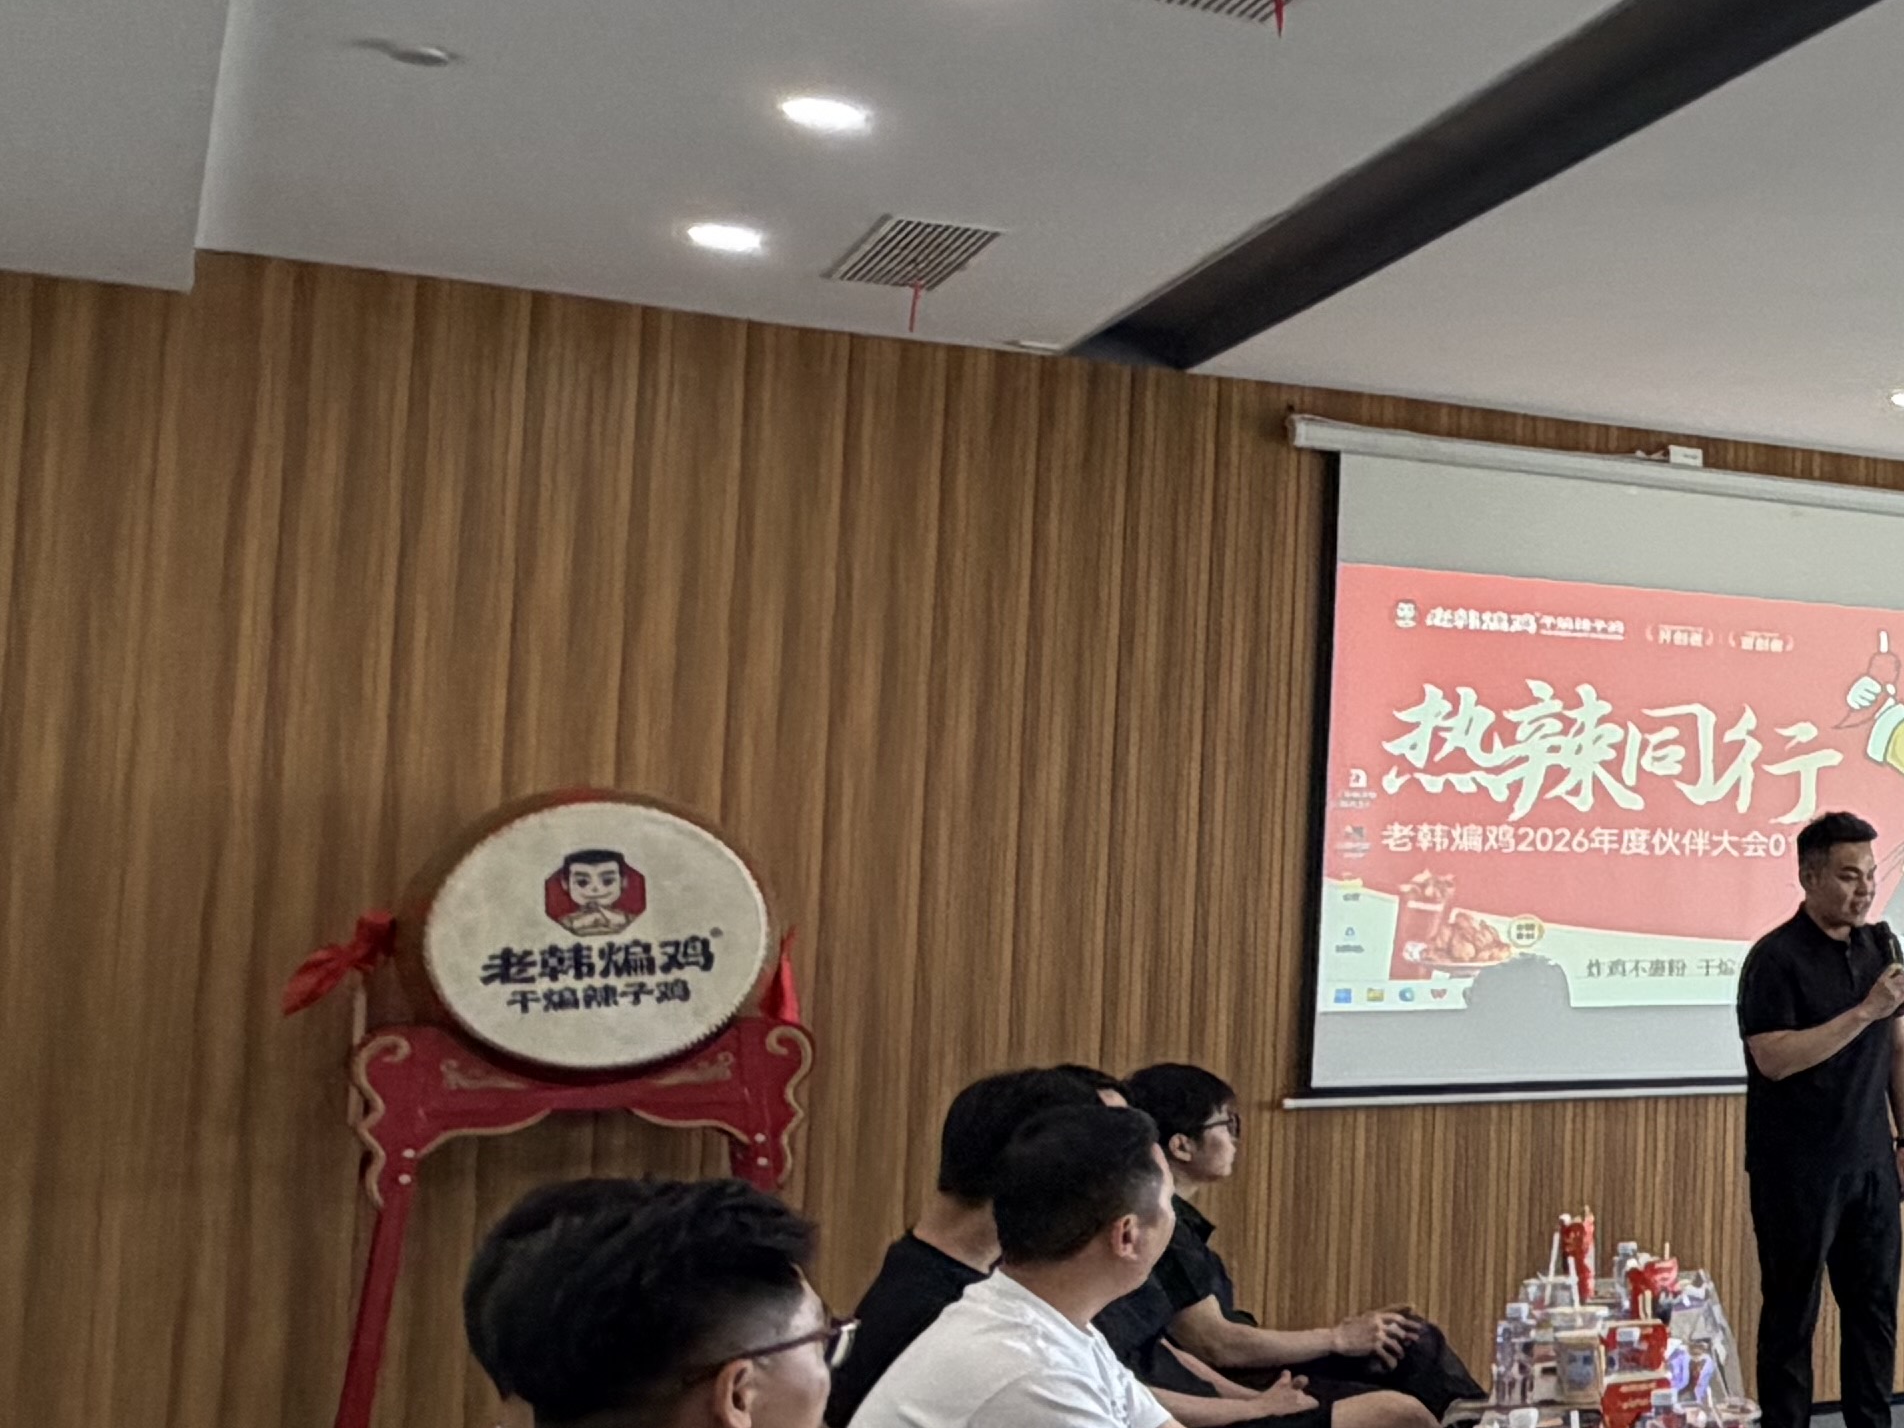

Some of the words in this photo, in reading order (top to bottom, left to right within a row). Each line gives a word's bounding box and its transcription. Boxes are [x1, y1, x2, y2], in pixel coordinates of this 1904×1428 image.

[1382, 678, 1844, 824] 热辣同行
[1381, 822, 1797, 858] 老韩煸鸡2026年度伙伴大会0
[480, 935, 714, 985] 老韩煸鸡
[507, 978, 691, 1014] 干煸辣子鸡
